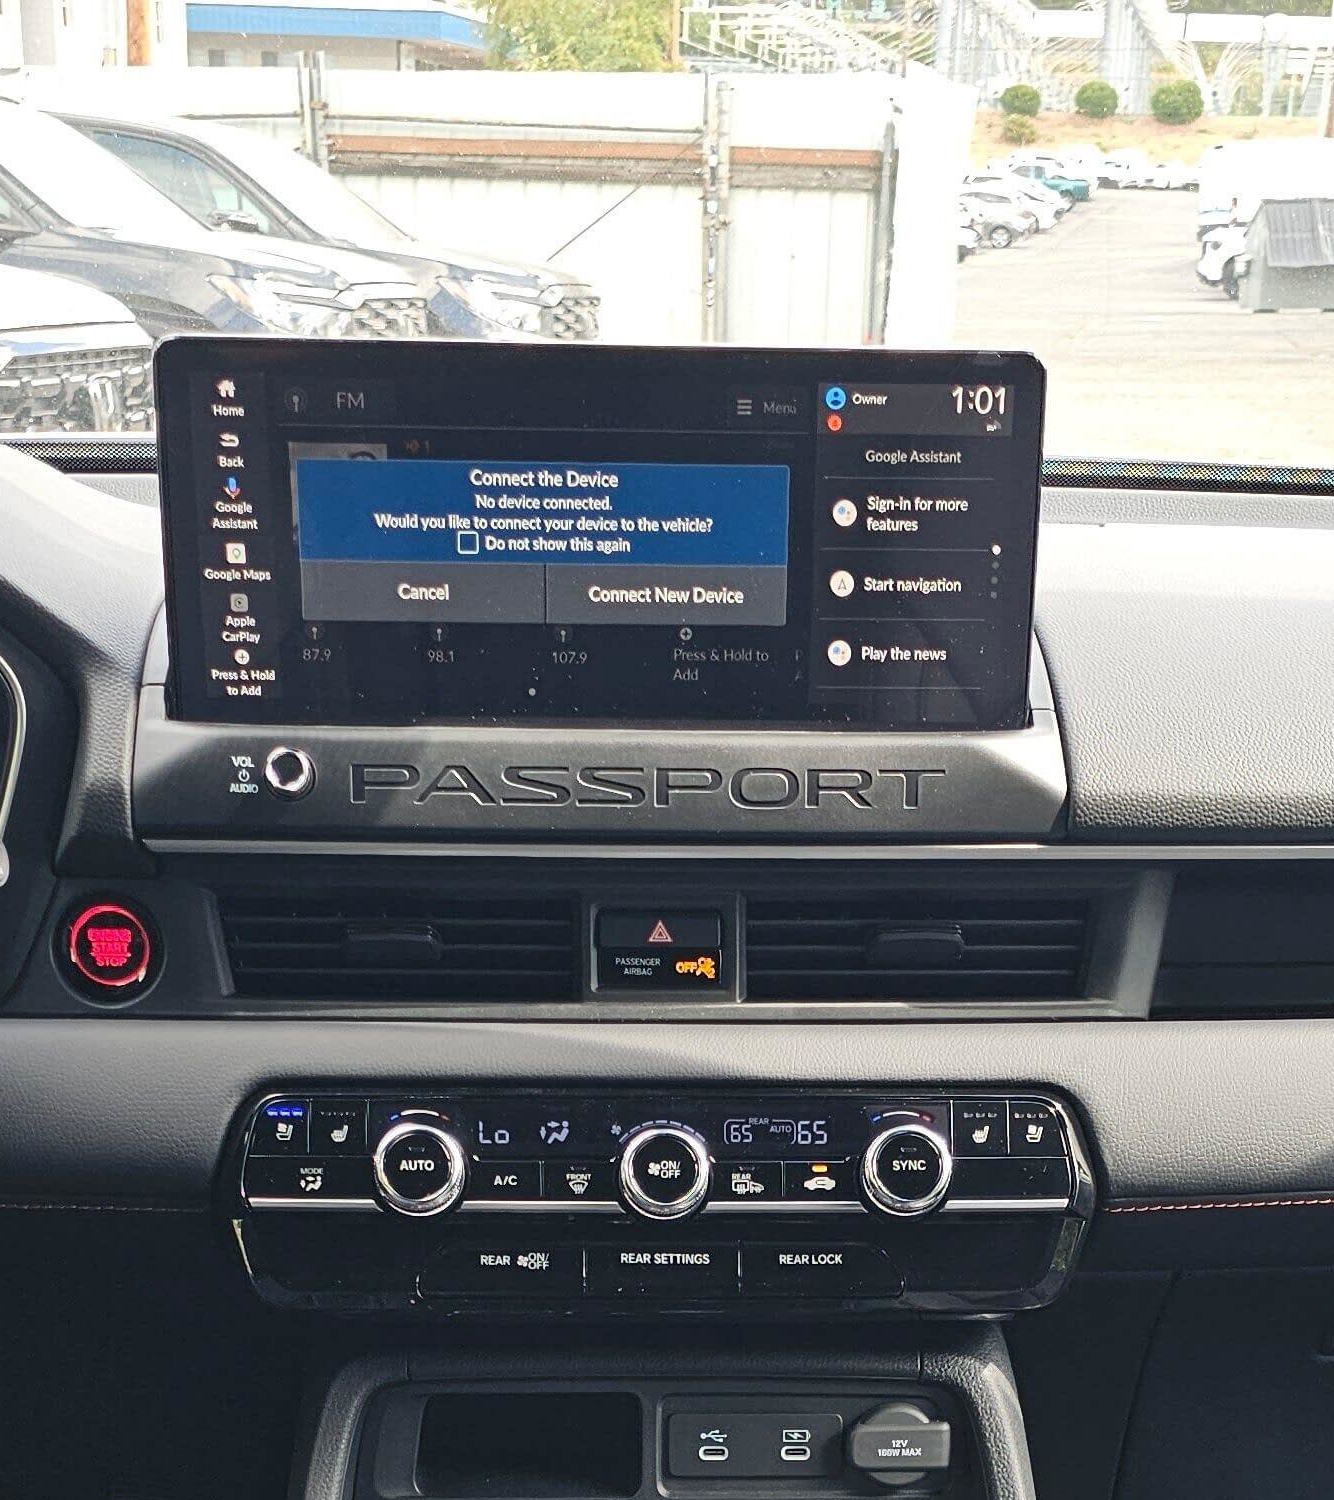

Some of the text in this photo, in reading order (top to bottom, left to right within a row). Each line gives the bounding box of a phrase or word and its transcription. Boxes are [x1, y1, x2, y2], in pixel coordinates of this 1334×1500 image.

[336, 392, 365, 409] FM
[852, 394, 887, 406] Owner
[952, 386, 1006, 416] 1:01
[212, 404, 245, 416] Home
[763, 401, 798, 415] Menu
[218, 455, 245, 468] Back
[865, 450, 962, 465] Google Assistant
[470, 469, 619, 488] Connect the Device
[215, 501, 253, 514] Google
[475, 494, 613, 511] No device connected.
[867, 496, 969, 514] Sign-in for more
[212, 518, 259, 530] Assistant
[374, 514, 714, 533] Would you like to connect your device to the vehicle?
[867, 518, 919, 532] features
[485, 536, 631, 554] Do not show this again
[204, 568, 271, 582] Google Maps
[397, 584, 450, 601] Cancel
[864, 577, 962, 595] Start navigation
[588, 586, 744, 604] Connect New Device
[225, 616, 256, 627] Apple
[222, 631, 261, 644] CarPlay
[303, 648, 331, 662] 87.9
[427, 649, 455, 663] 98.1
[551, 651, 588, 665] 107.9
[673, 649, 770, 662] Press & Hold to
[861, 647, 947, 662] Play the news
[211, 669, 275, 680] Press & Hold
[673, 668, 699, 681] Add
[227, 686, 261, 696] to Add
[231, 756, 255, 768] VOL
[229, 783, 259, 794] AUDIO
[349, 763, 946, 812] PASSPORT
[91, 942, 129, 954] START
[95, 956, 127, 967] STOP
[615, 958, 661, 966] PASSENGER
[675, 961, 697, 974] OFF
[623, 968, 653, 976] AIRBAG
[730, 1124, 753, 1142] 65
[769, 1125, 793, 1134] AUTO
[797, 1120, 827, 1145] 65
[300, 1167, 323, 1175] MODE
[399, 1158, 435, 1172] AUTO
[660, 1160, 681, 1172] ON/
[892, 1158, 927, 1172] SYNC
[493, 1174, 518, 1186] A/C
[567, 1173, 592, 1182] FRONT
[660, 1168, 681, 1179] OFF
[480, 1254, 511, 1266] REAR
[527, 1252, 549, 1264] ON/
[620, 1253, 710, 1266] REAR SETTINGS
[779, 1254, 843, 1265] REAR LOCK
[527, 1261, 549, 1270] OFF
[891, 1440, 909, 1448] 12V
[901, 1448, 922, 1456] MAX
